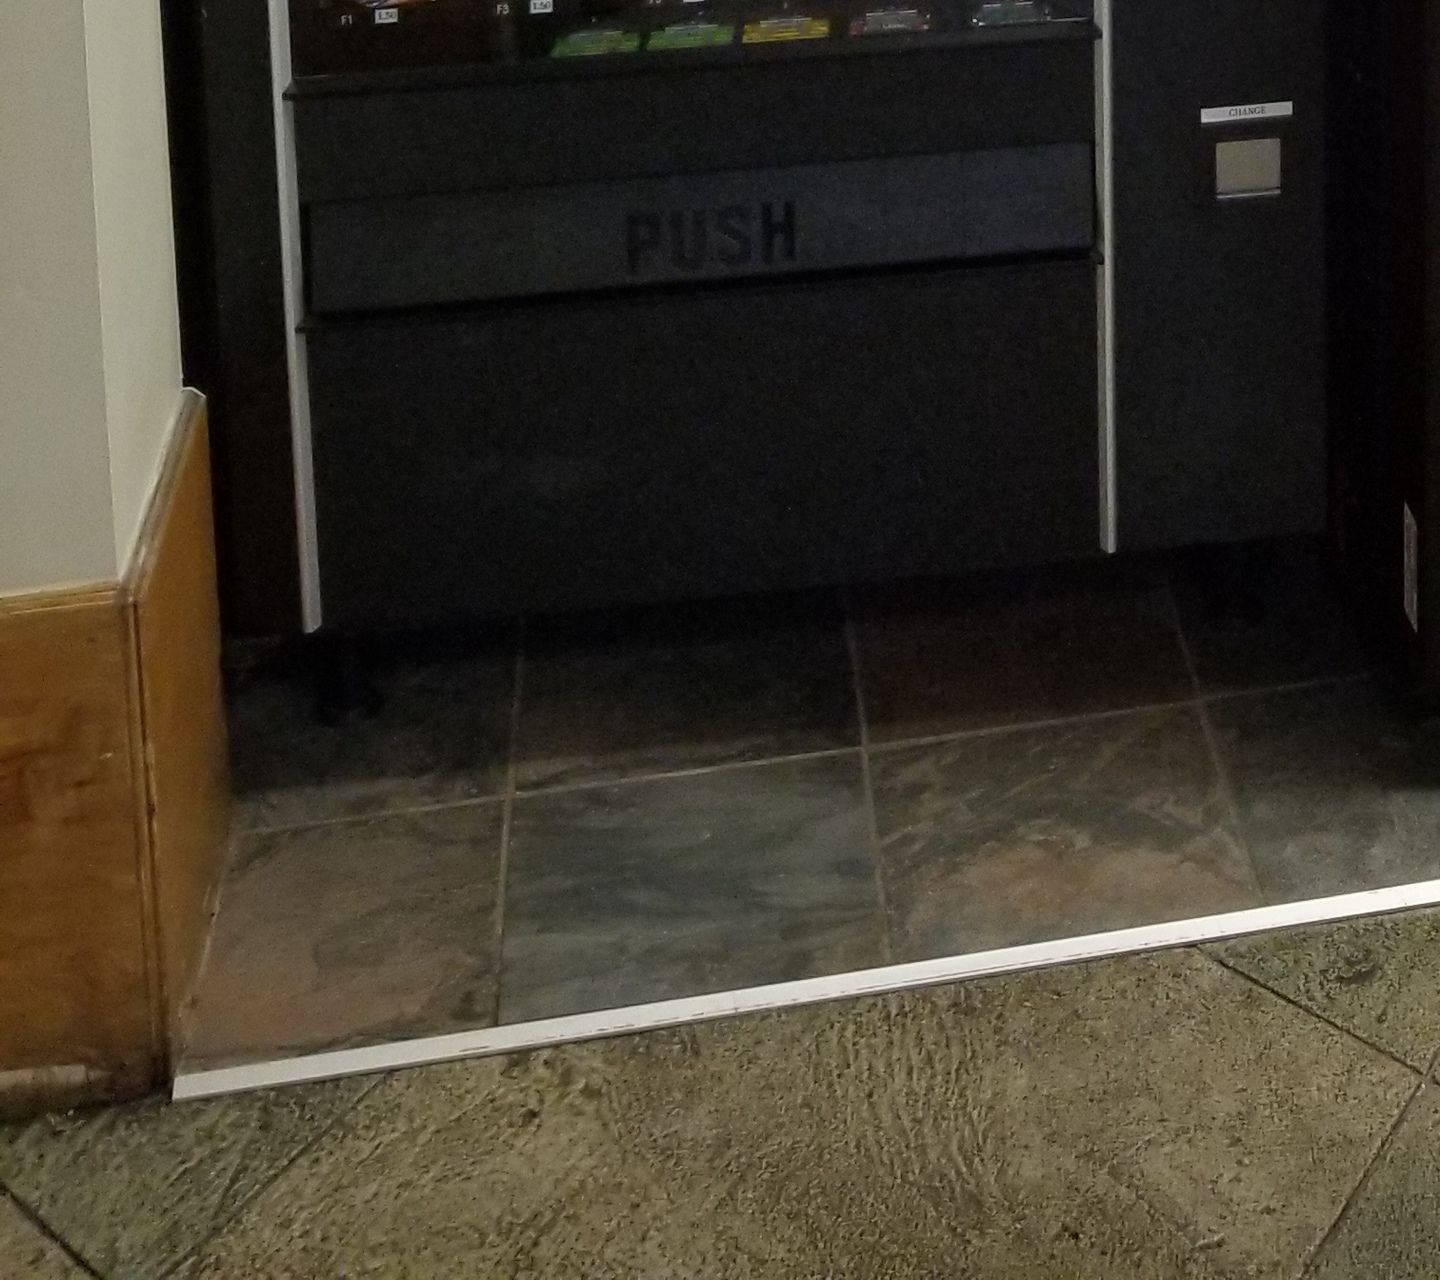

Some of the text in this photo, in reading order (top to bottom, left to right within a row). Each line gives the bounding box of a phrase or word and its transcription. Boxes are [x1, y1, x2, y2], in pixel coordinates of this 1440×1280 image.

[497, 3, 509, 15] F3
[341, 14, 353, 26] F1
[1228, 106, 1266, 117] CHANGE
[626, 201, 796, 276] PUSH
